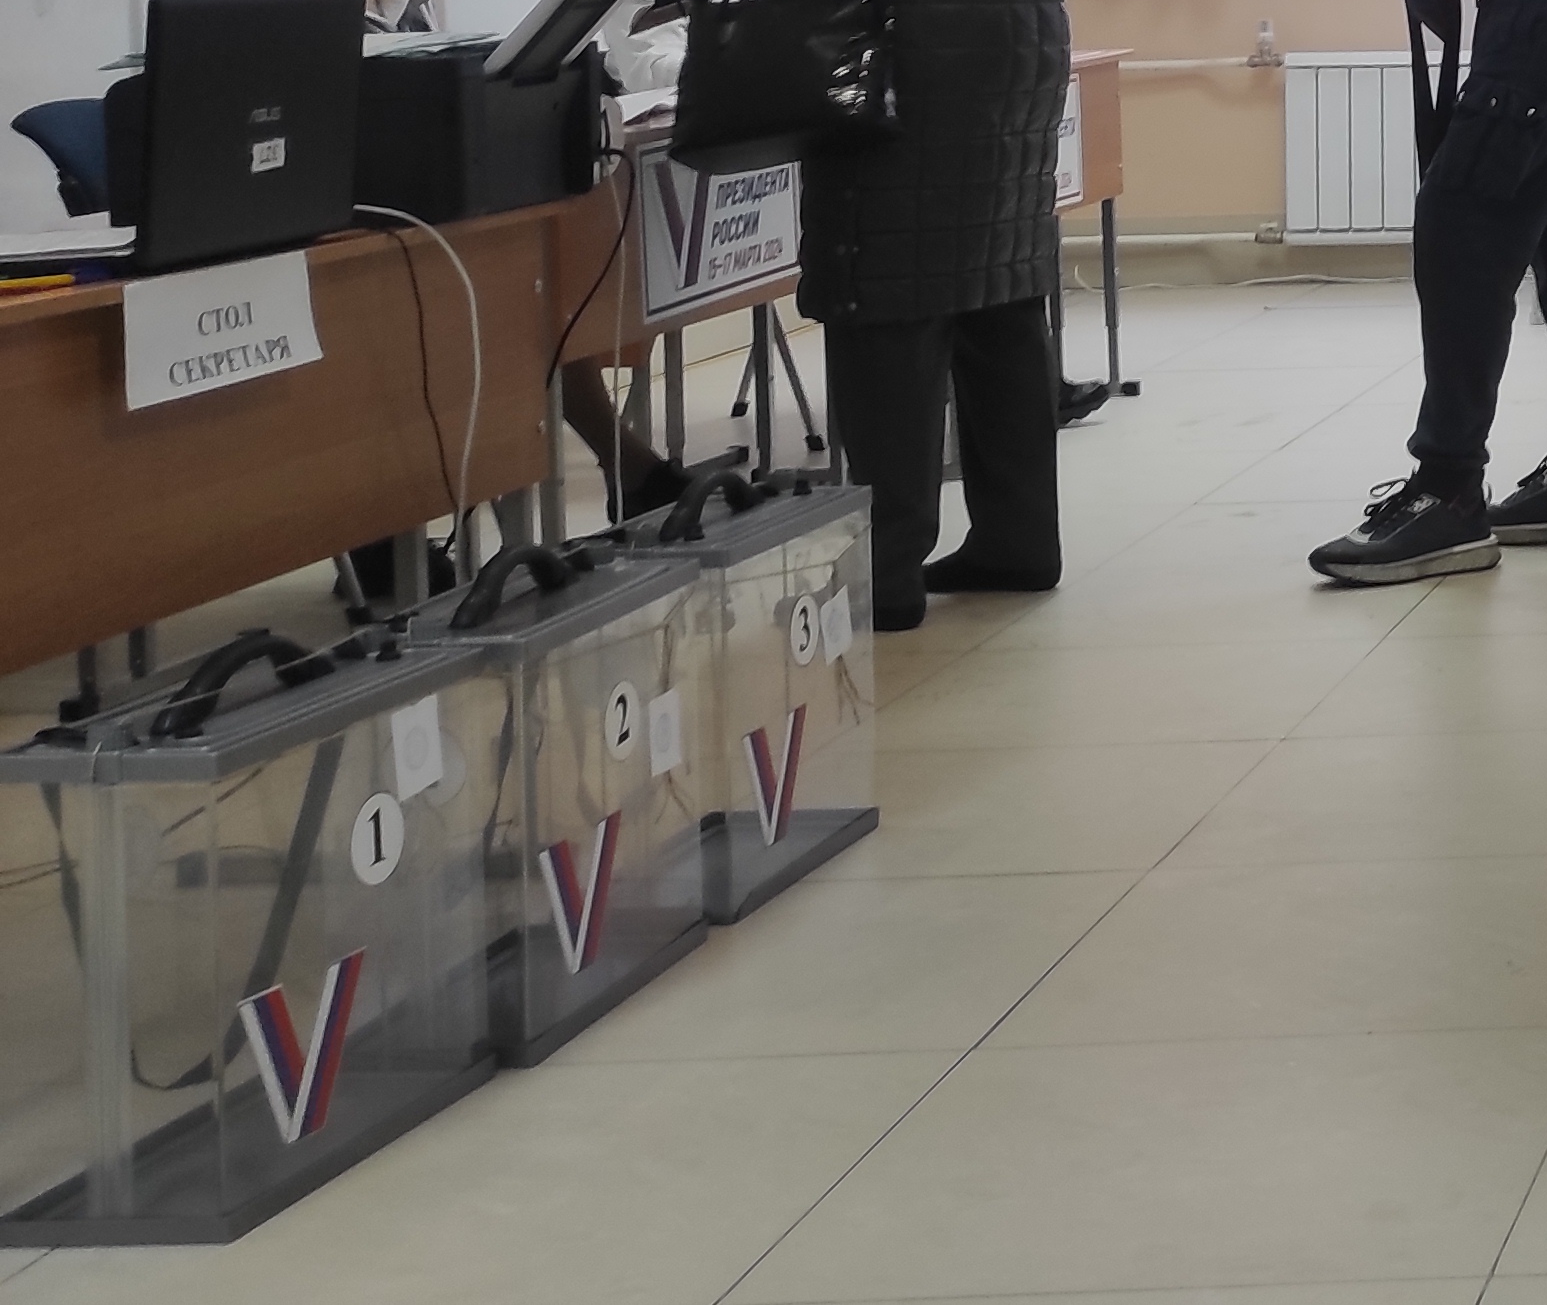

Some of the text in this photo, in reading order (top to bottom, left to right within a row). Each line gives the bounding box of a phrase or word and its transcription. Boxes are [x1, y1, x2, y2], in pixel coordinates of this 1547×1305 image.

[716, 168, 790, 210] ПРЕЗИДЕНТА
[711, 209, 761, 249] РОССИИ
[733, 244, 761, 273] МАРТА
[197, 301, 253, 336] СТОЛ
[168, 335, 292, 387] СЕКРЕТАРЯ
[797, 605, 813, 655] 3
[613, 692, 632, 748] 2
[369, 807, 388, 865] 1
